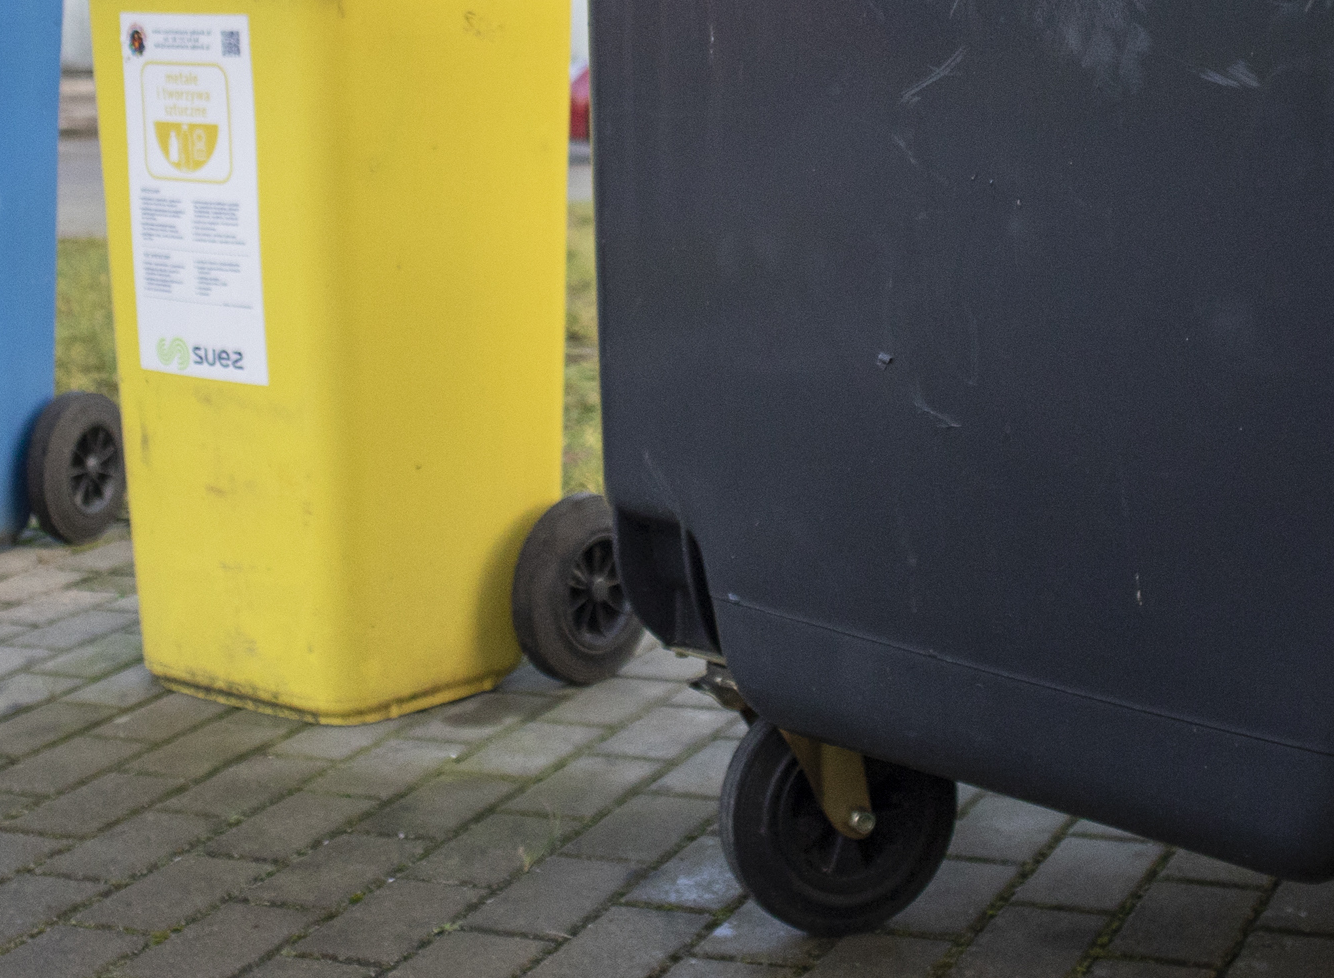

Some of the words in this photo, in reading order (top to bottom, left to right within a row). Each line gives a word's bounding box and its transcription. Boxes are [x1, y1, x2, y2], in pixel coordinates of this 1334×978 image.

[165, 72, 198, 85] metale
[162, 86, 210, 103] tworzywa
[193, 346, 244, 369] suez
